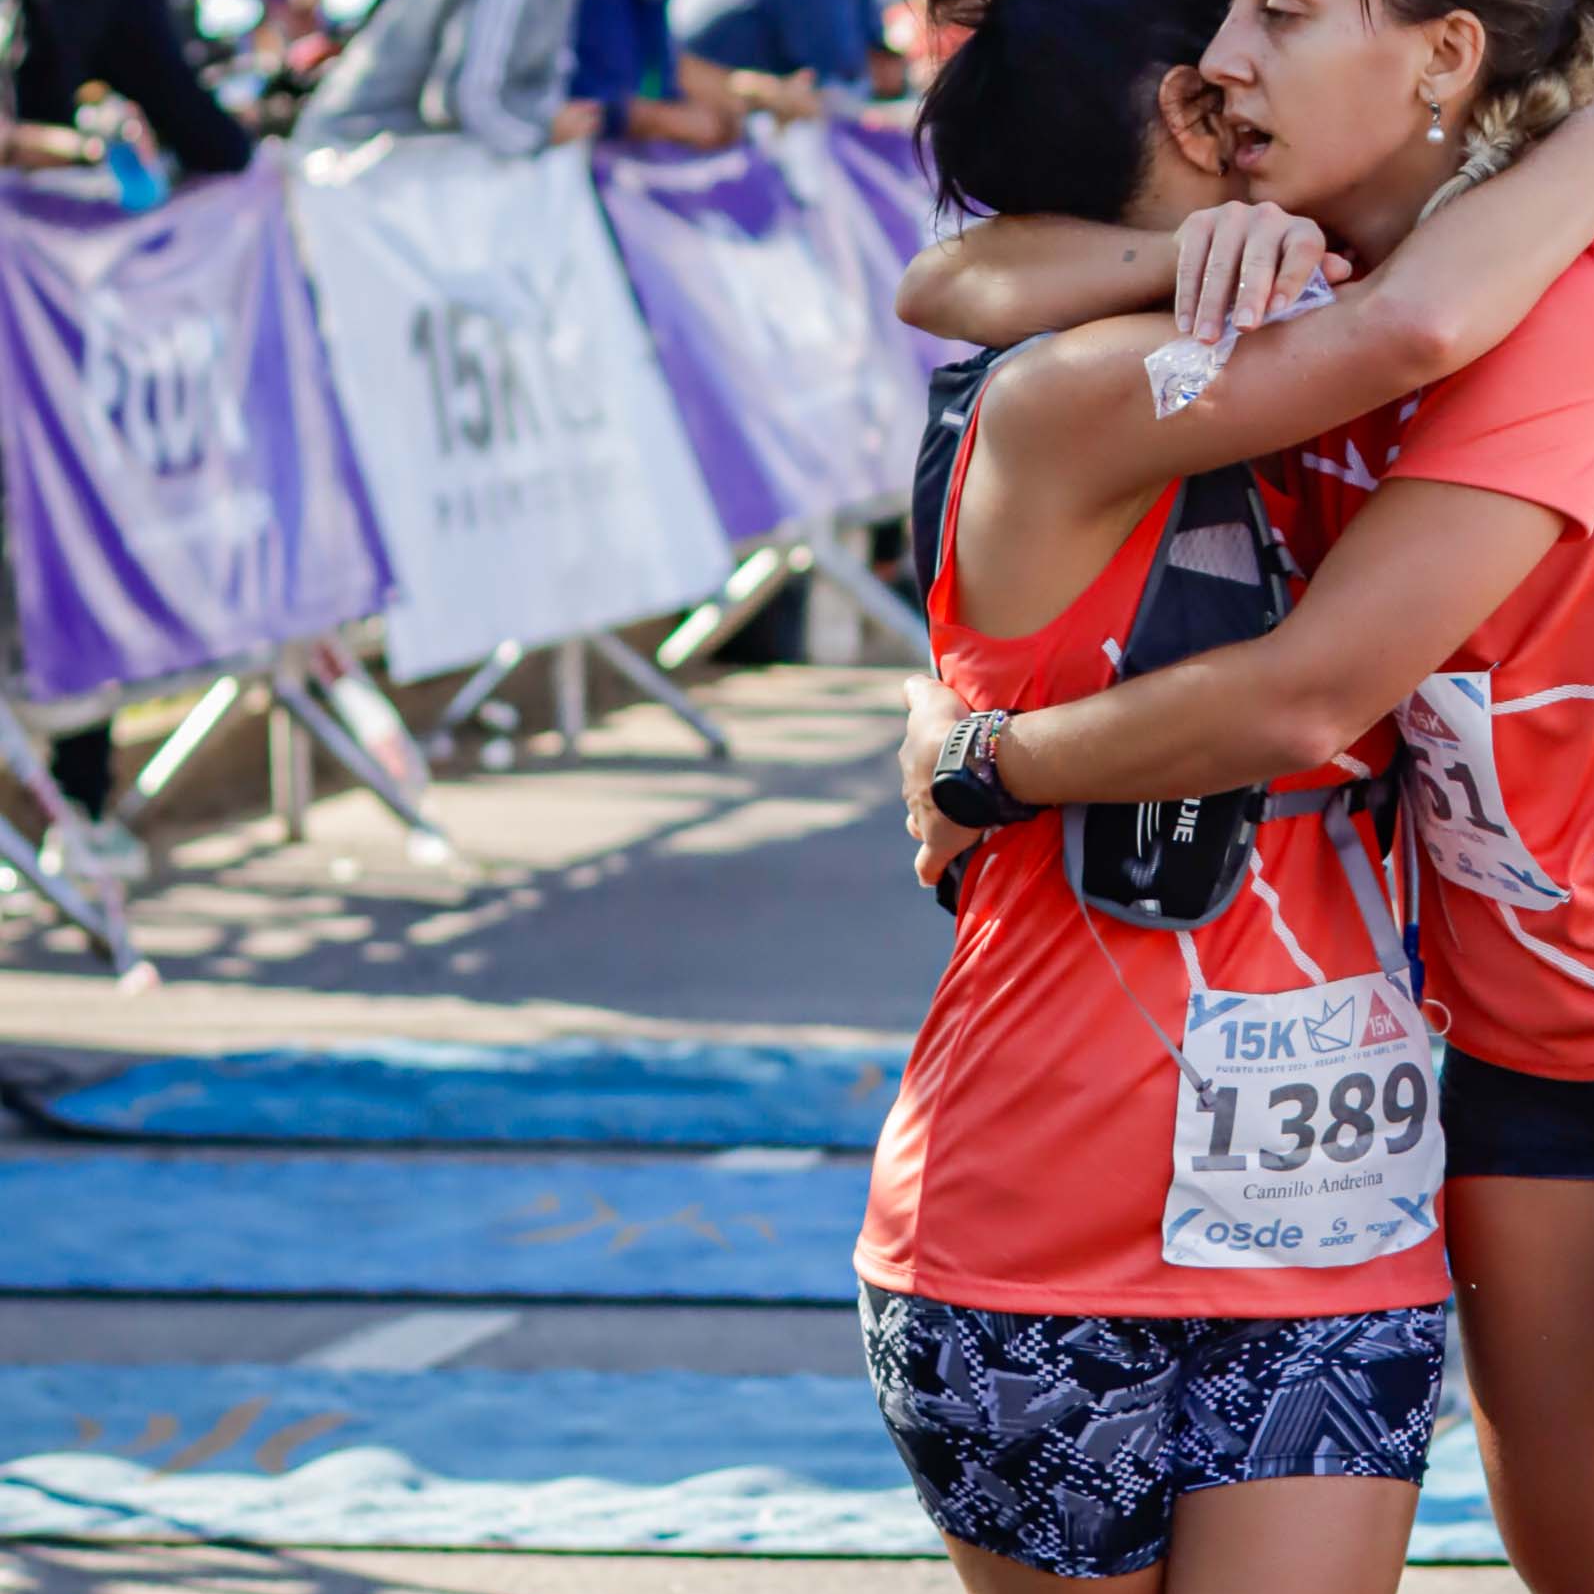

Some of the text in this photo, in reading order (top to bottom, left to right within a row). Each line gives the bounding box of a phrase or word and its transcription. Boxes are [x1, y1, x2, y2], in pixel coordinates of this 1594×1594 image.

[1219, 1019, 1299, 1061] 15K
[1368, 1014, 1399, 1037] 15K
[1191, 1062, 1428, 1172] 1389
[1243, 1172, 1383, 1200] Cannillo Andreina
[1205, 1218, 1303, 1251] osde
